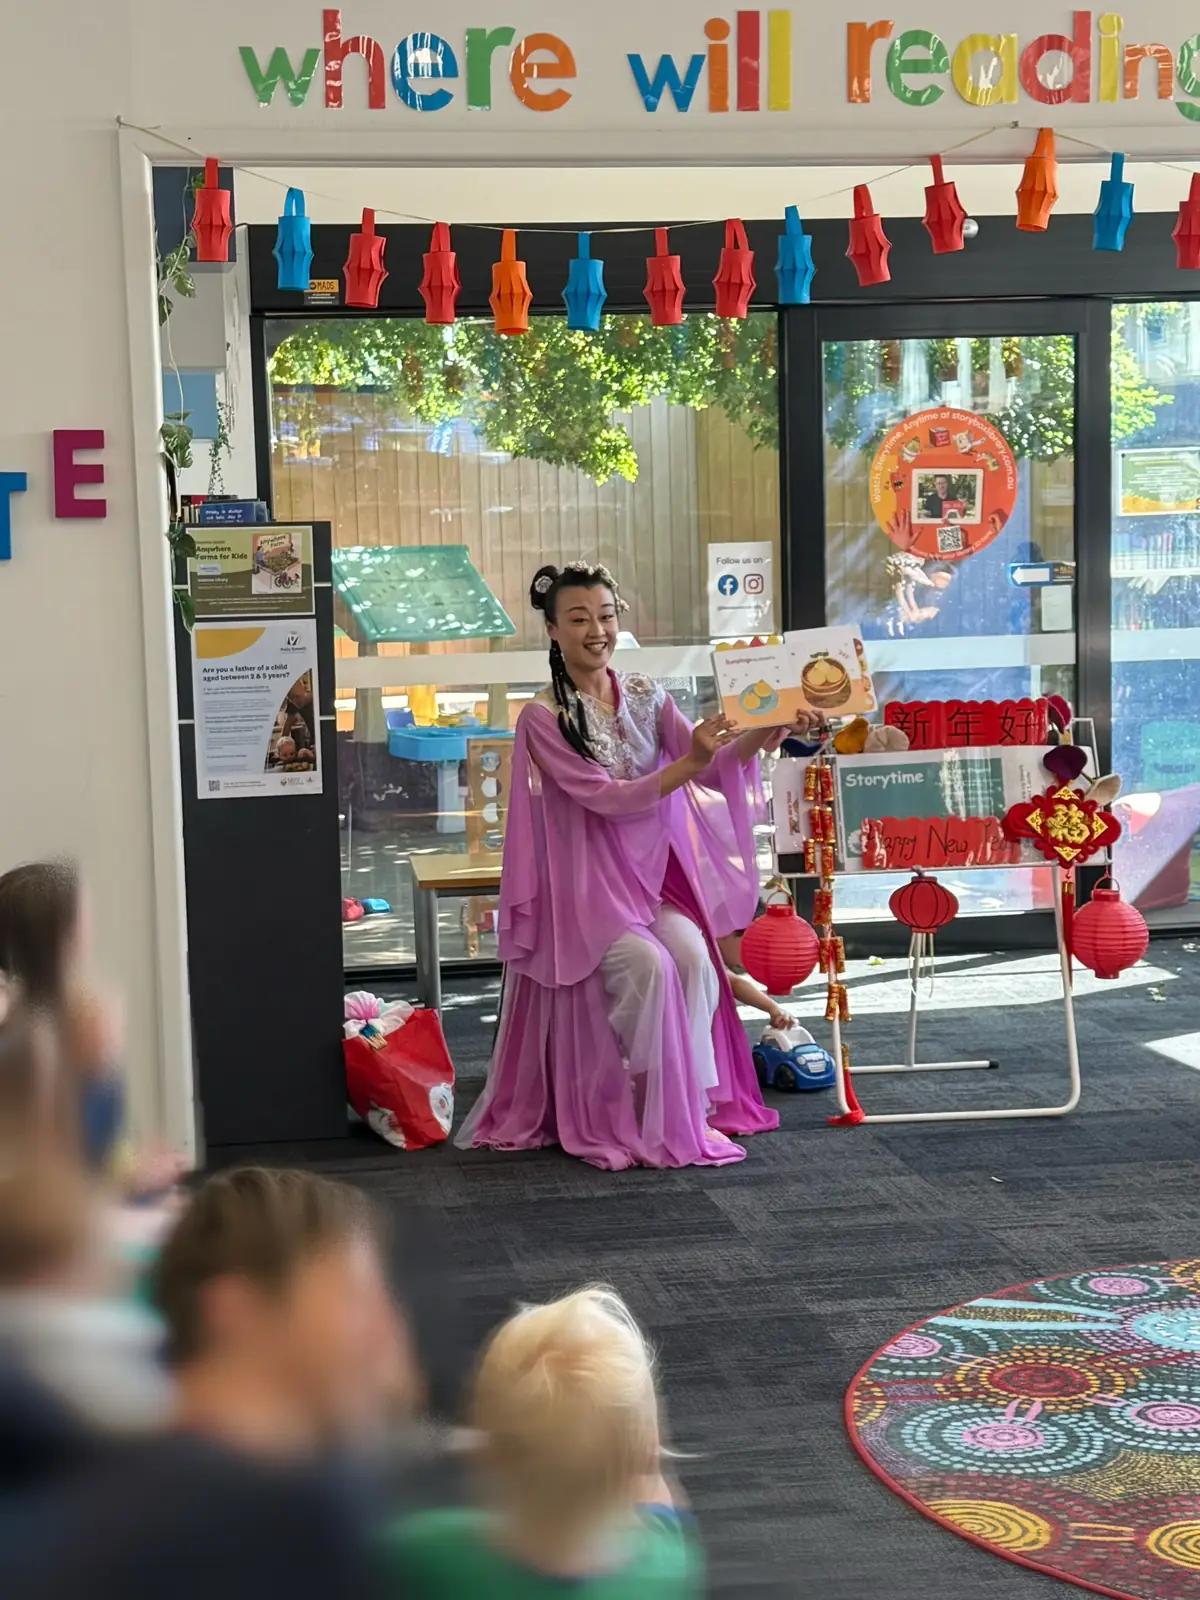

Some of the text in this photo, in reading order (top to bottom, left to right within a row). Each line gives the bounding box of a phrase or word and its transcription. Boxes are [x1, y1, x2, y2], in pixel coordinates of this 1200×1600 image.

[238, 9, 577, 111] where
[627, 10, 791, 112] will
[904, 413, 938, 433] Anytime
[196, 545, 231, 553] Anywhere
[220, 673, 249, 681] between
[268, 672, 290, 680] years?
[845, 770, 924, 789] Storytime
[927, 821, 968, 859] New
